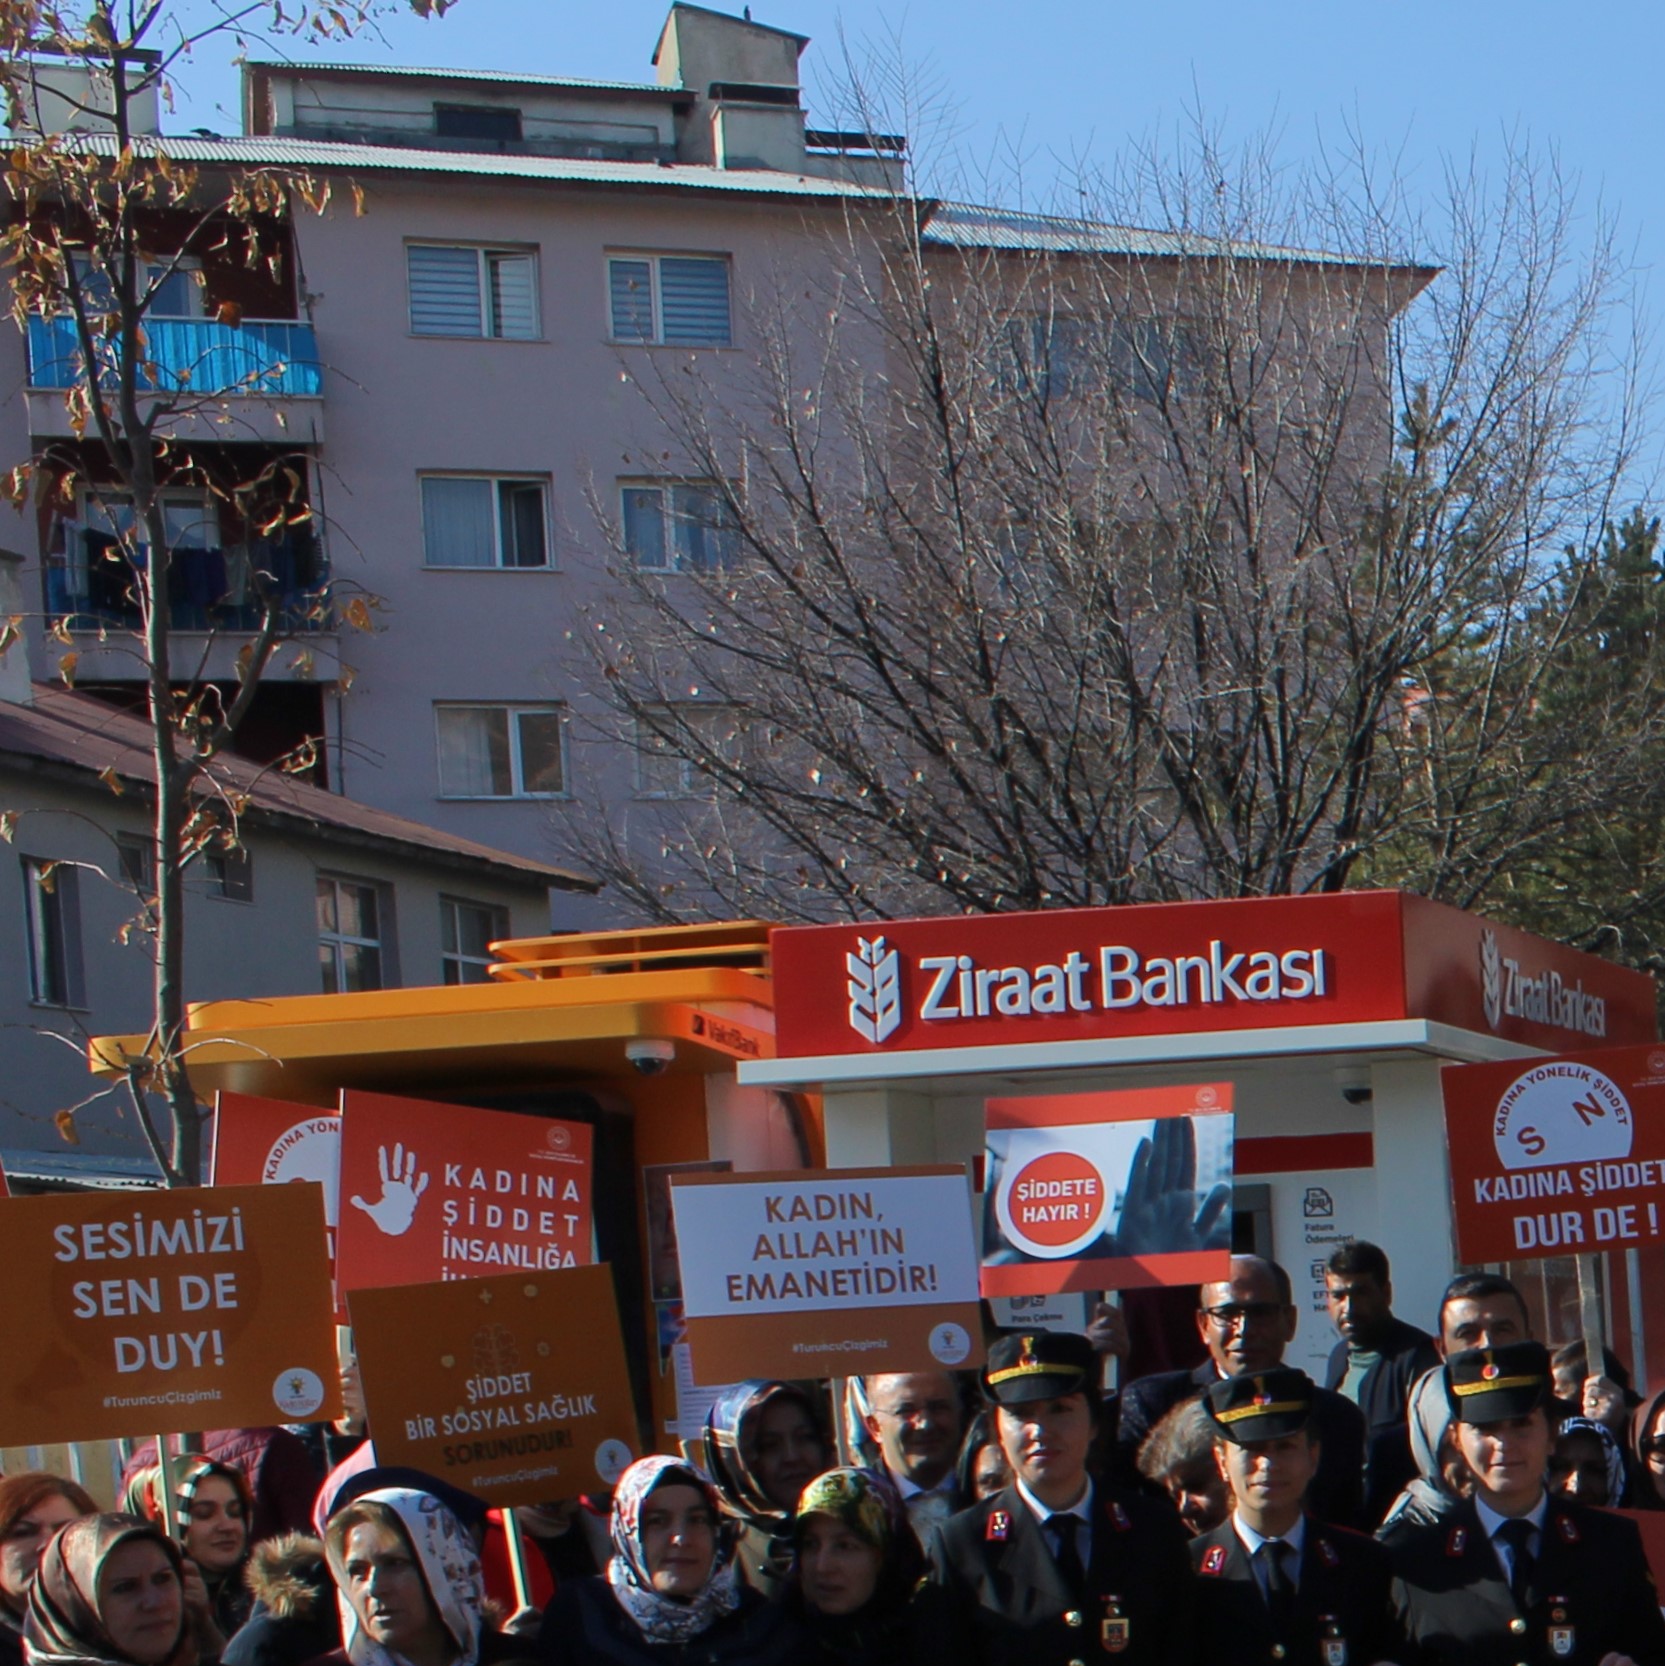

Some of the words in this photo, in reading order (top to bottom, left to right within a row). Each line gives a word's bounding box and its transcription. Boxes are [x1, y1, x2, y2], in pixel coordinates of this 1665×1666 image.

[919, 951, 1091, 1021] Ziraat
[1100, 939, 1325, 1010] Bankası
[1503, 958, 1550, 1024] Ziraat
[1551, 970, 1606, 1037] Bankası
[1496, 1084, 1526, 1136] KADINA
[1526, 1066, 1591, 1084] YÖNELİK
[1593, 1078, 1628, 1125] ŞİDDET
[265, 1129, 304, 1180] KADINA
[445, 1163, 580, 1202] KADINA
[1017, 1177, 1096, 1202] ŞİDDETE
[1473, 1167, 1574, 1204] KADINA
[443, 1199, 579, 1237] ŞİDDET
[765, 1192, 884, 1224] KADIN,
[1022, 1203, 1076, 1223] HAYIR
[54, 1207, 244, 1262] SESİMİZİ
[752, 1227, 905, 1261] ALLAH'IN
[1514, 1213, 1584, 1251] DUR
[1593, 1205, 1639, 1242] DE
[442, 1235, 576, 1270] İNSANLIĞA
[73, 1277, 161, 1319] SEN
[179, 1273, 238, 1311] DE
[726, 1262, 937, 1301] EMANETİDİR!
[114, 1329, 224, 1373] DUY!
[466, 1372, 532, 1404] ŞİDDET
[405, 1414, 436, 1440] BİR
[442, 1406, 520, 1436] SOSYAL
[526, 1394, 597, 1424] SAĞLIK
[442, 1430, 573, 1467] SORUNUDUR!
